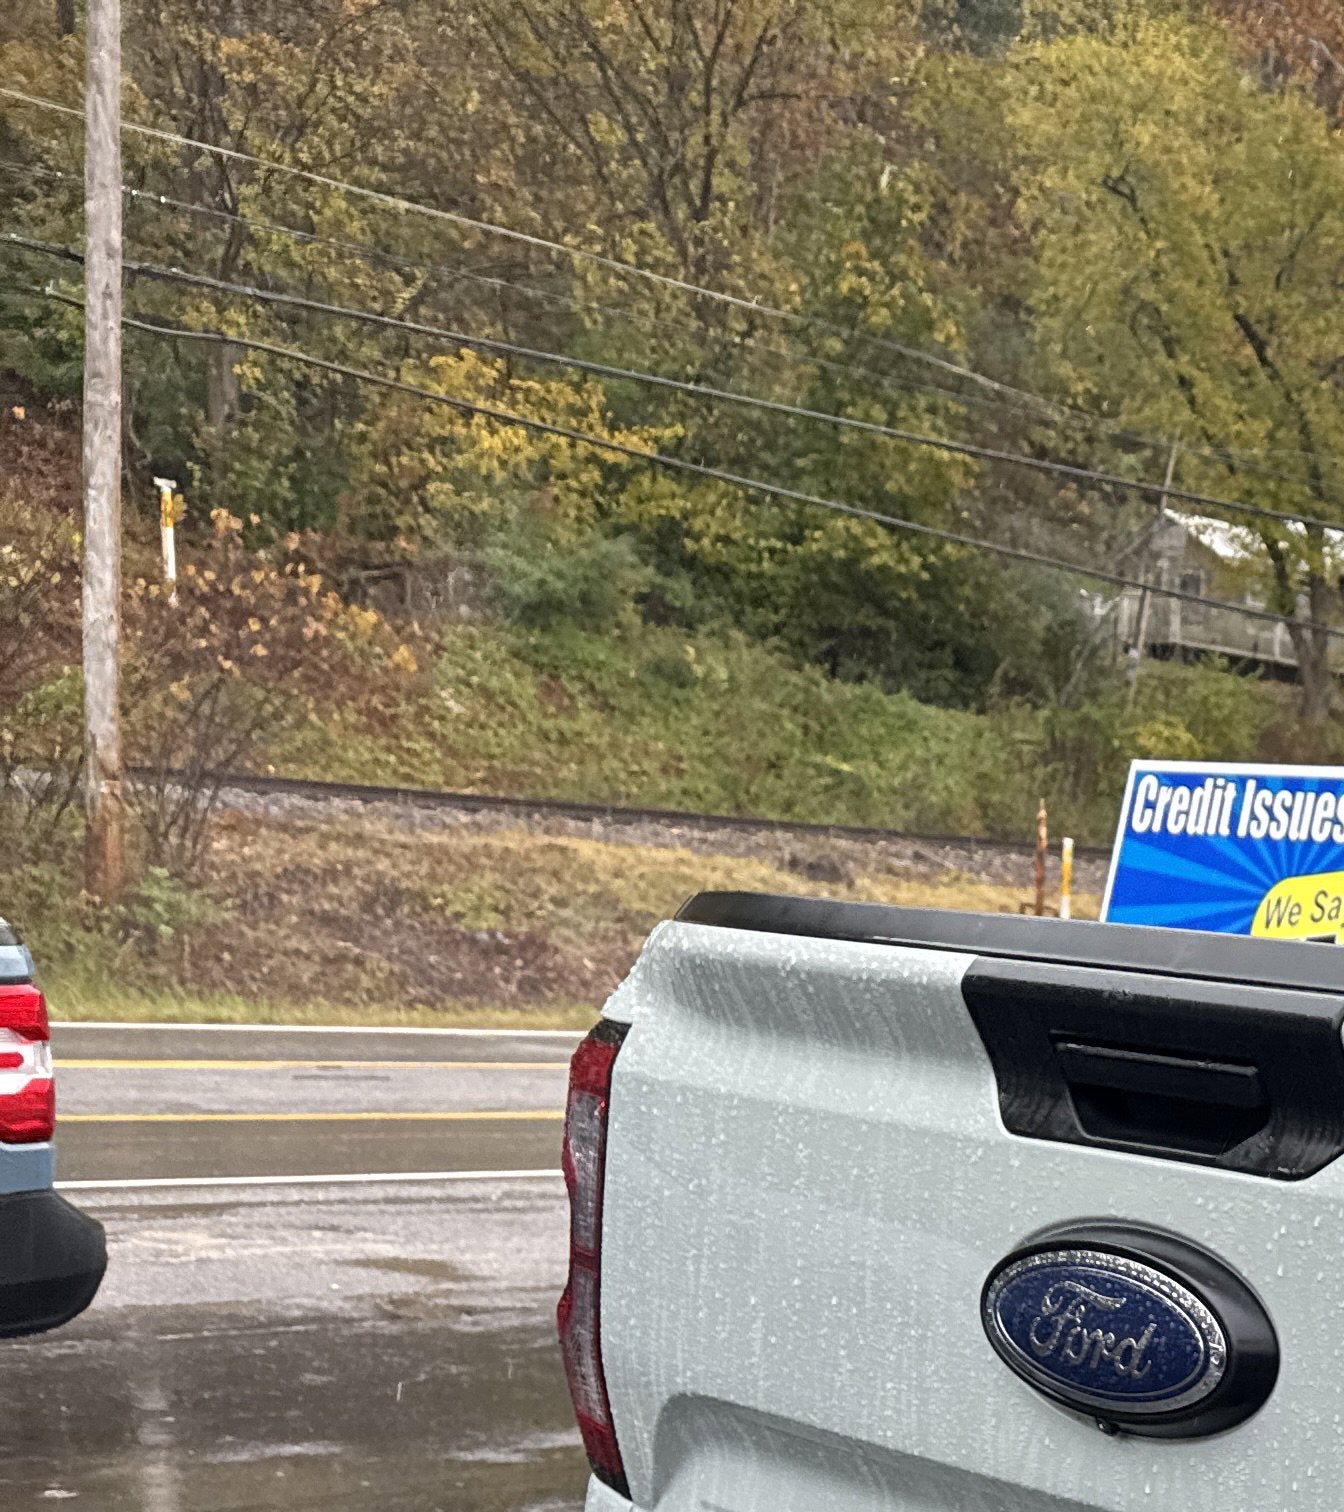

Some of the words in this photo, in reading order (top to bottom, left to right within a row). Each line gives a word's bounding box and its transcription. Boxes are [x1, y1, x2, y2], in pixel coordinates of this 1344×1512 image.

[1130, 773, 1238, 838] Credit
[1264, 894, 1303, 930] We
[1029, 1279, 1158, 1380] Ford
